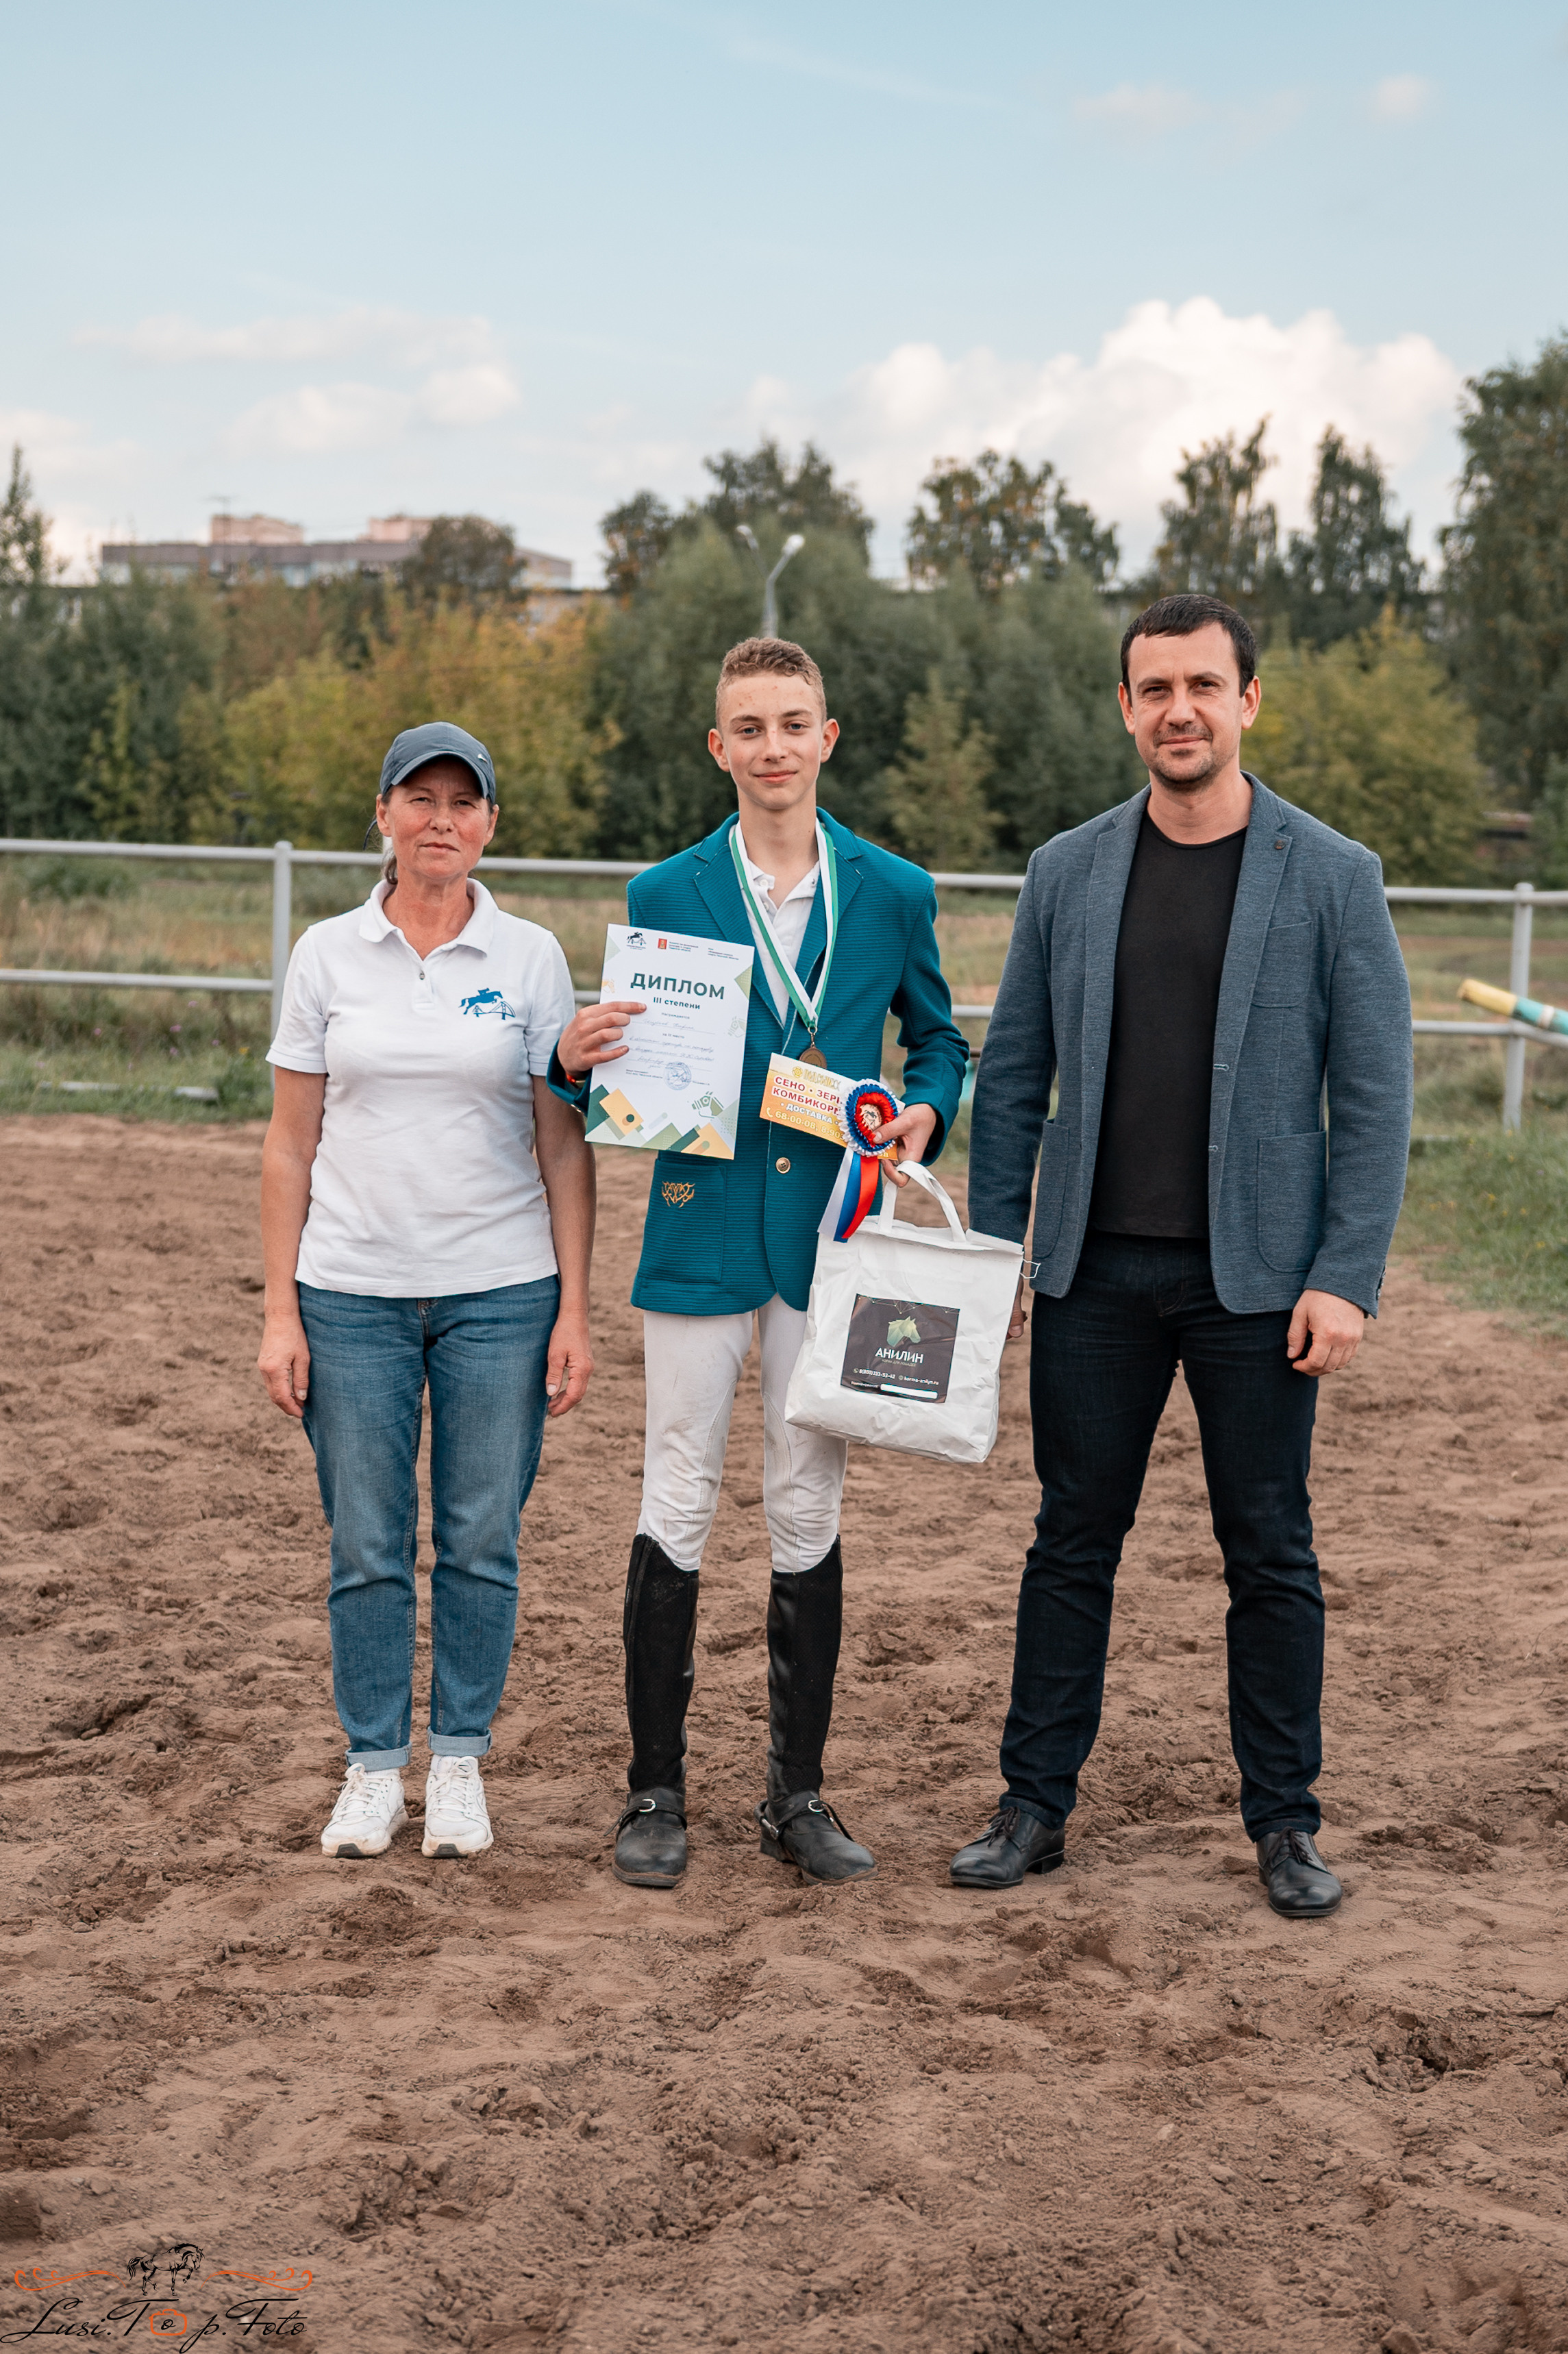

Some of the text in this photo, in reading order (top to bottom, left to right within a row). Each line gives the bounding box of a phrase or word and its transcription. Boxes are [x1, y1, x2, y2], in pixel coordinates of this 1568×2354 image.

[630, 972, 725, 1000] ДИПЛОМ
[664, 999, 701, 1010] степени
[775, 1076, 806, 1091] СЕНО
[786, 1102, 833, 1124] ДОСТАВКА
[875, 1347, 924, 1364] АНИЛИН
